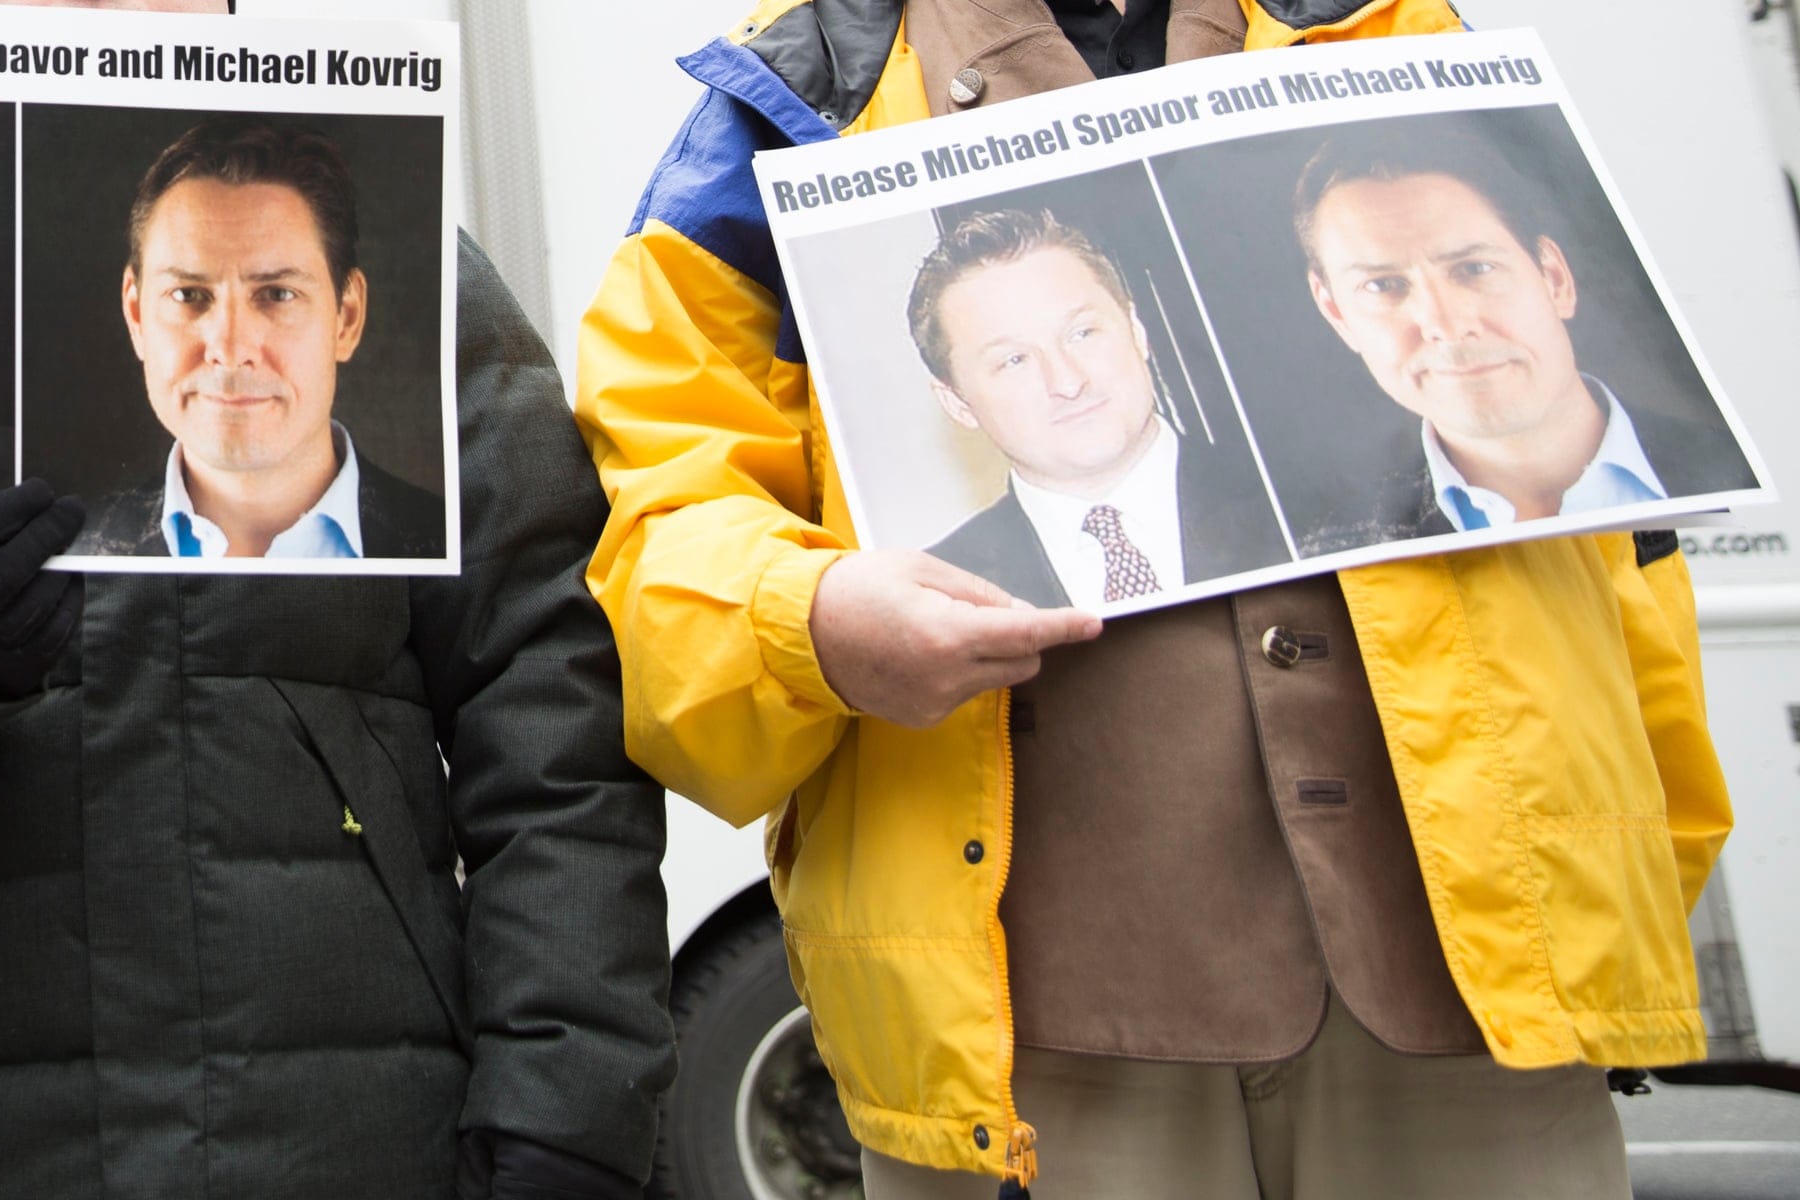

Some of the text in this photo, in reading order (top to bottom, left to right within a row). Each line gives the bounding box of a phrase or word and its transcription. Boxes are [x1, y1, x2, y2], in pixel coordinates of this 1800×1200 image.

[98, 44, 164, 80] and
[174, 45, 317, 85] Michael
[327, 49, 443, 93] Kovrig
[772, 54, 1543, 213] Release Michael Spavor and Michael Kovrig
